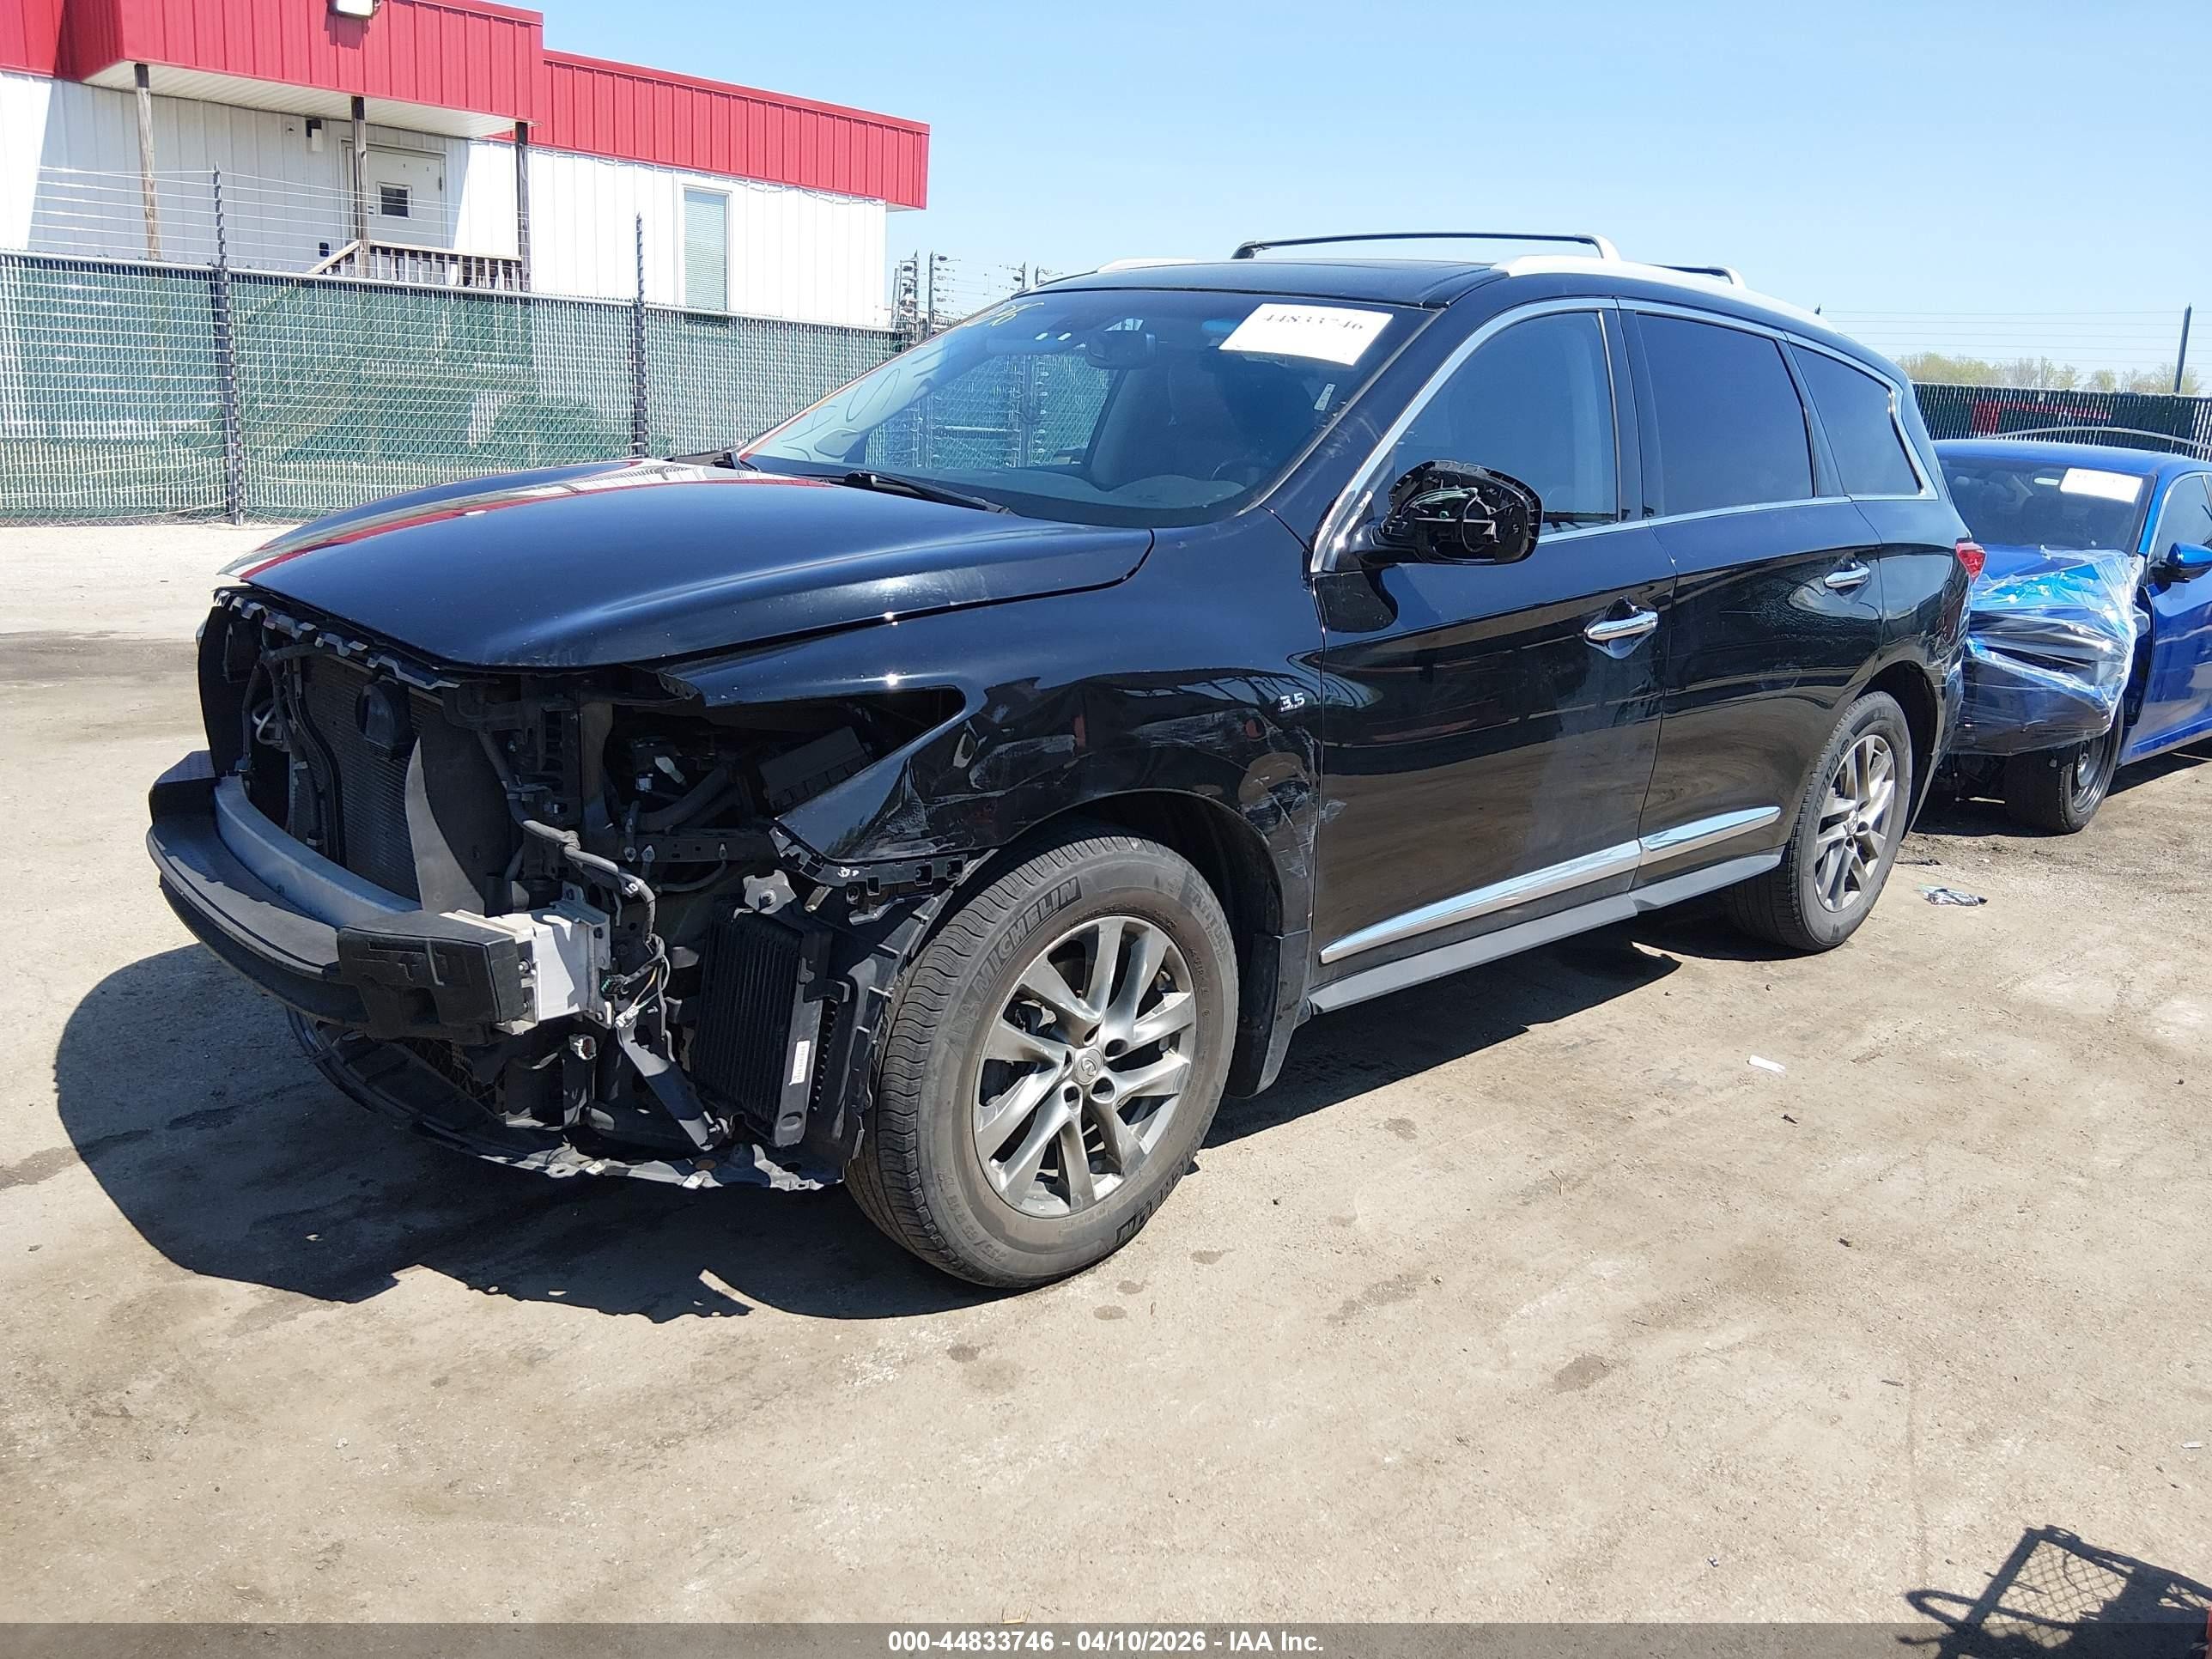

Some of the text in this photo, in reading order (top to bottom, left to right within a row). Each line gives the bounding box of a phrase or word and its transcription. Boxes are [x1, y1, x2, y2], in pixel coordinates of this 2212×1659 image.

[1264, 314, 1364, 331] 4483346
[1279, 692, 1305, 712] 3.5
[971, 878, 1079, 996] MICHELIN
